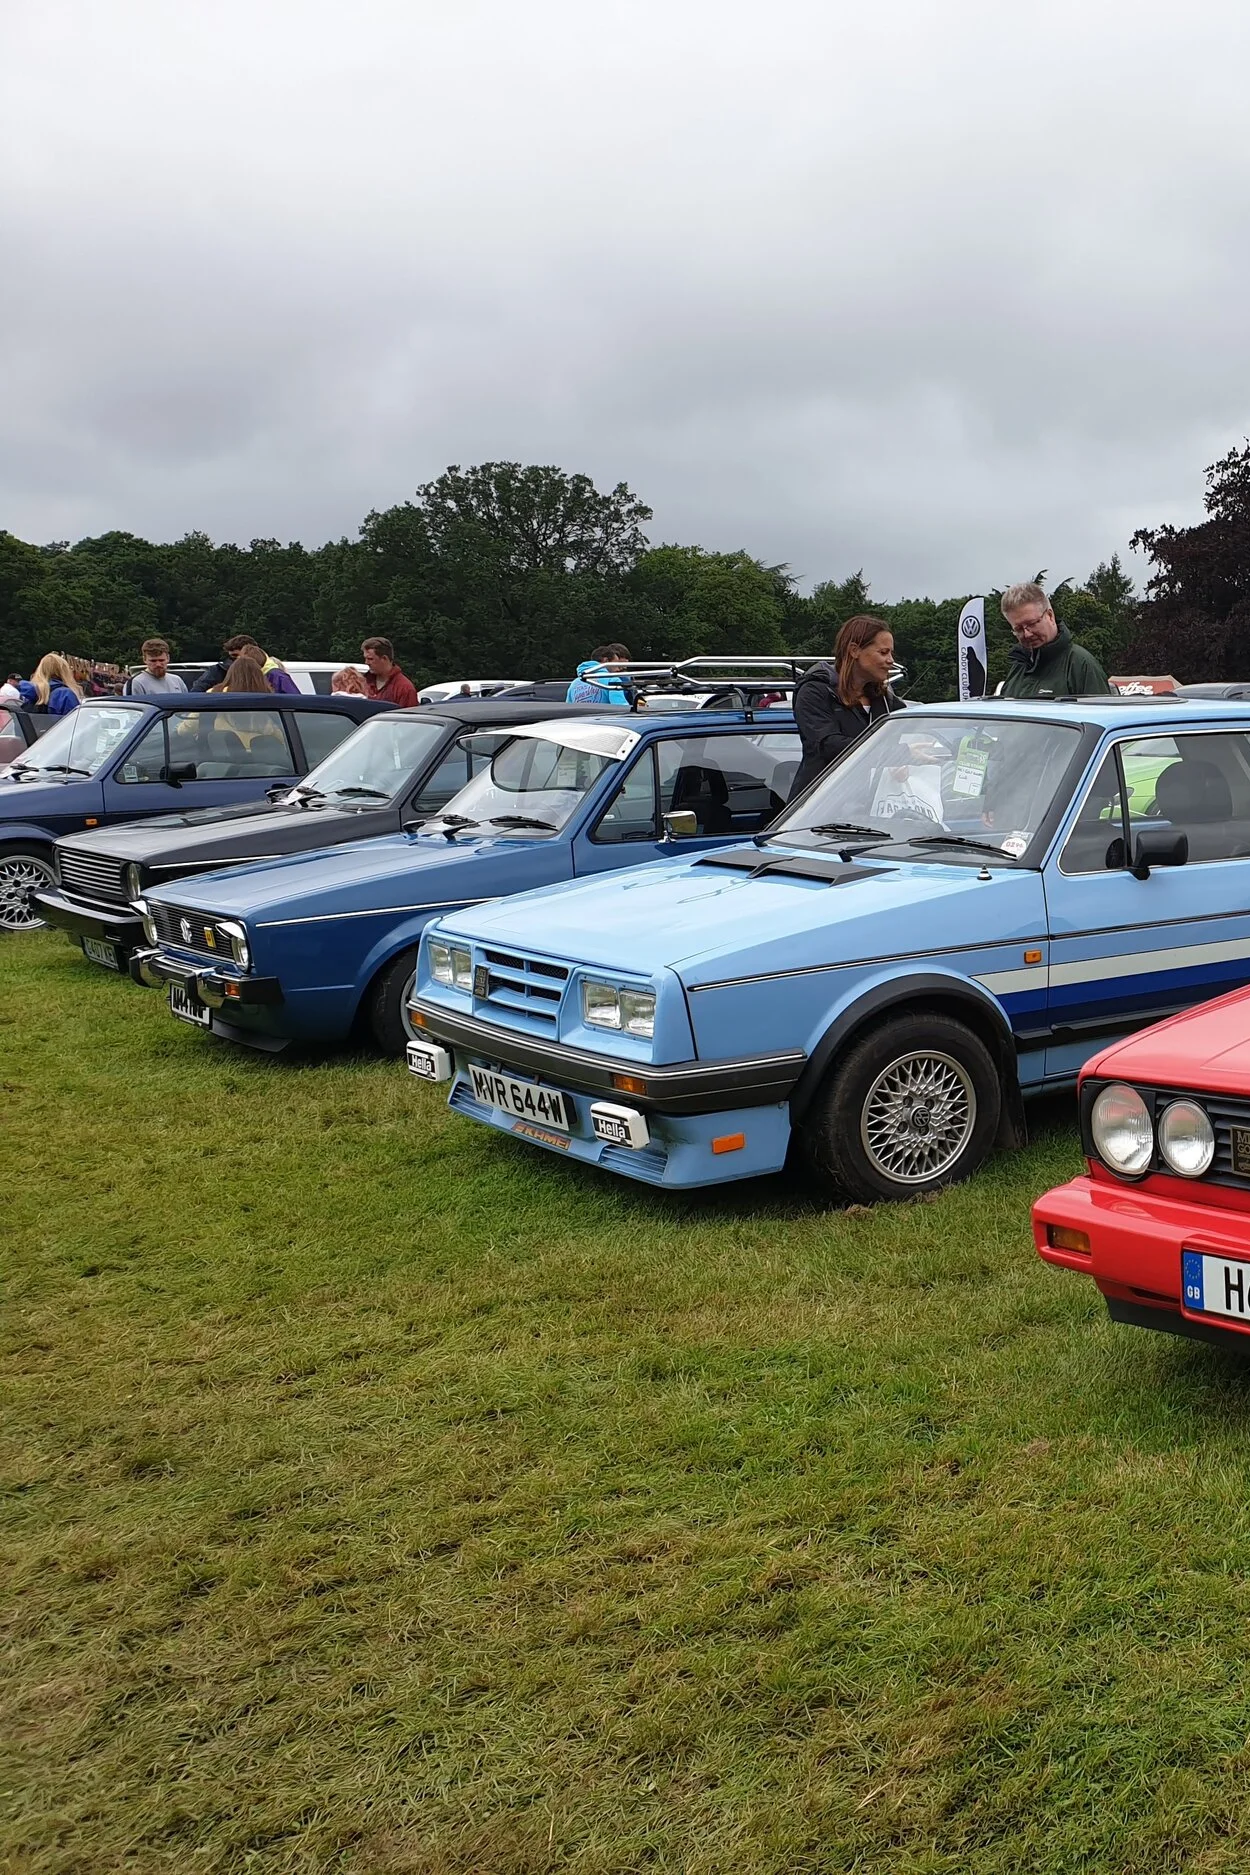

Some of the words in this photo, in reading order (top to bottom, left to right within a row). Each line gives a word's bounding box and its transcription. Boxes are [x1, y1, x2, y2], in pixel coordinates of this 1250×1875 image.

[1118, 682, 1153, 694] offee
[411, 1054, 433, 1072] Hella
[472, 1069, 509, 1108] MVR
[510, 1083, 563, 1125] 644W
[526, 1125, 571, 1150] KAMEI
[598, 1119, 626, 1138] Hella
[1186, 1285, 1201, 1300] GB
